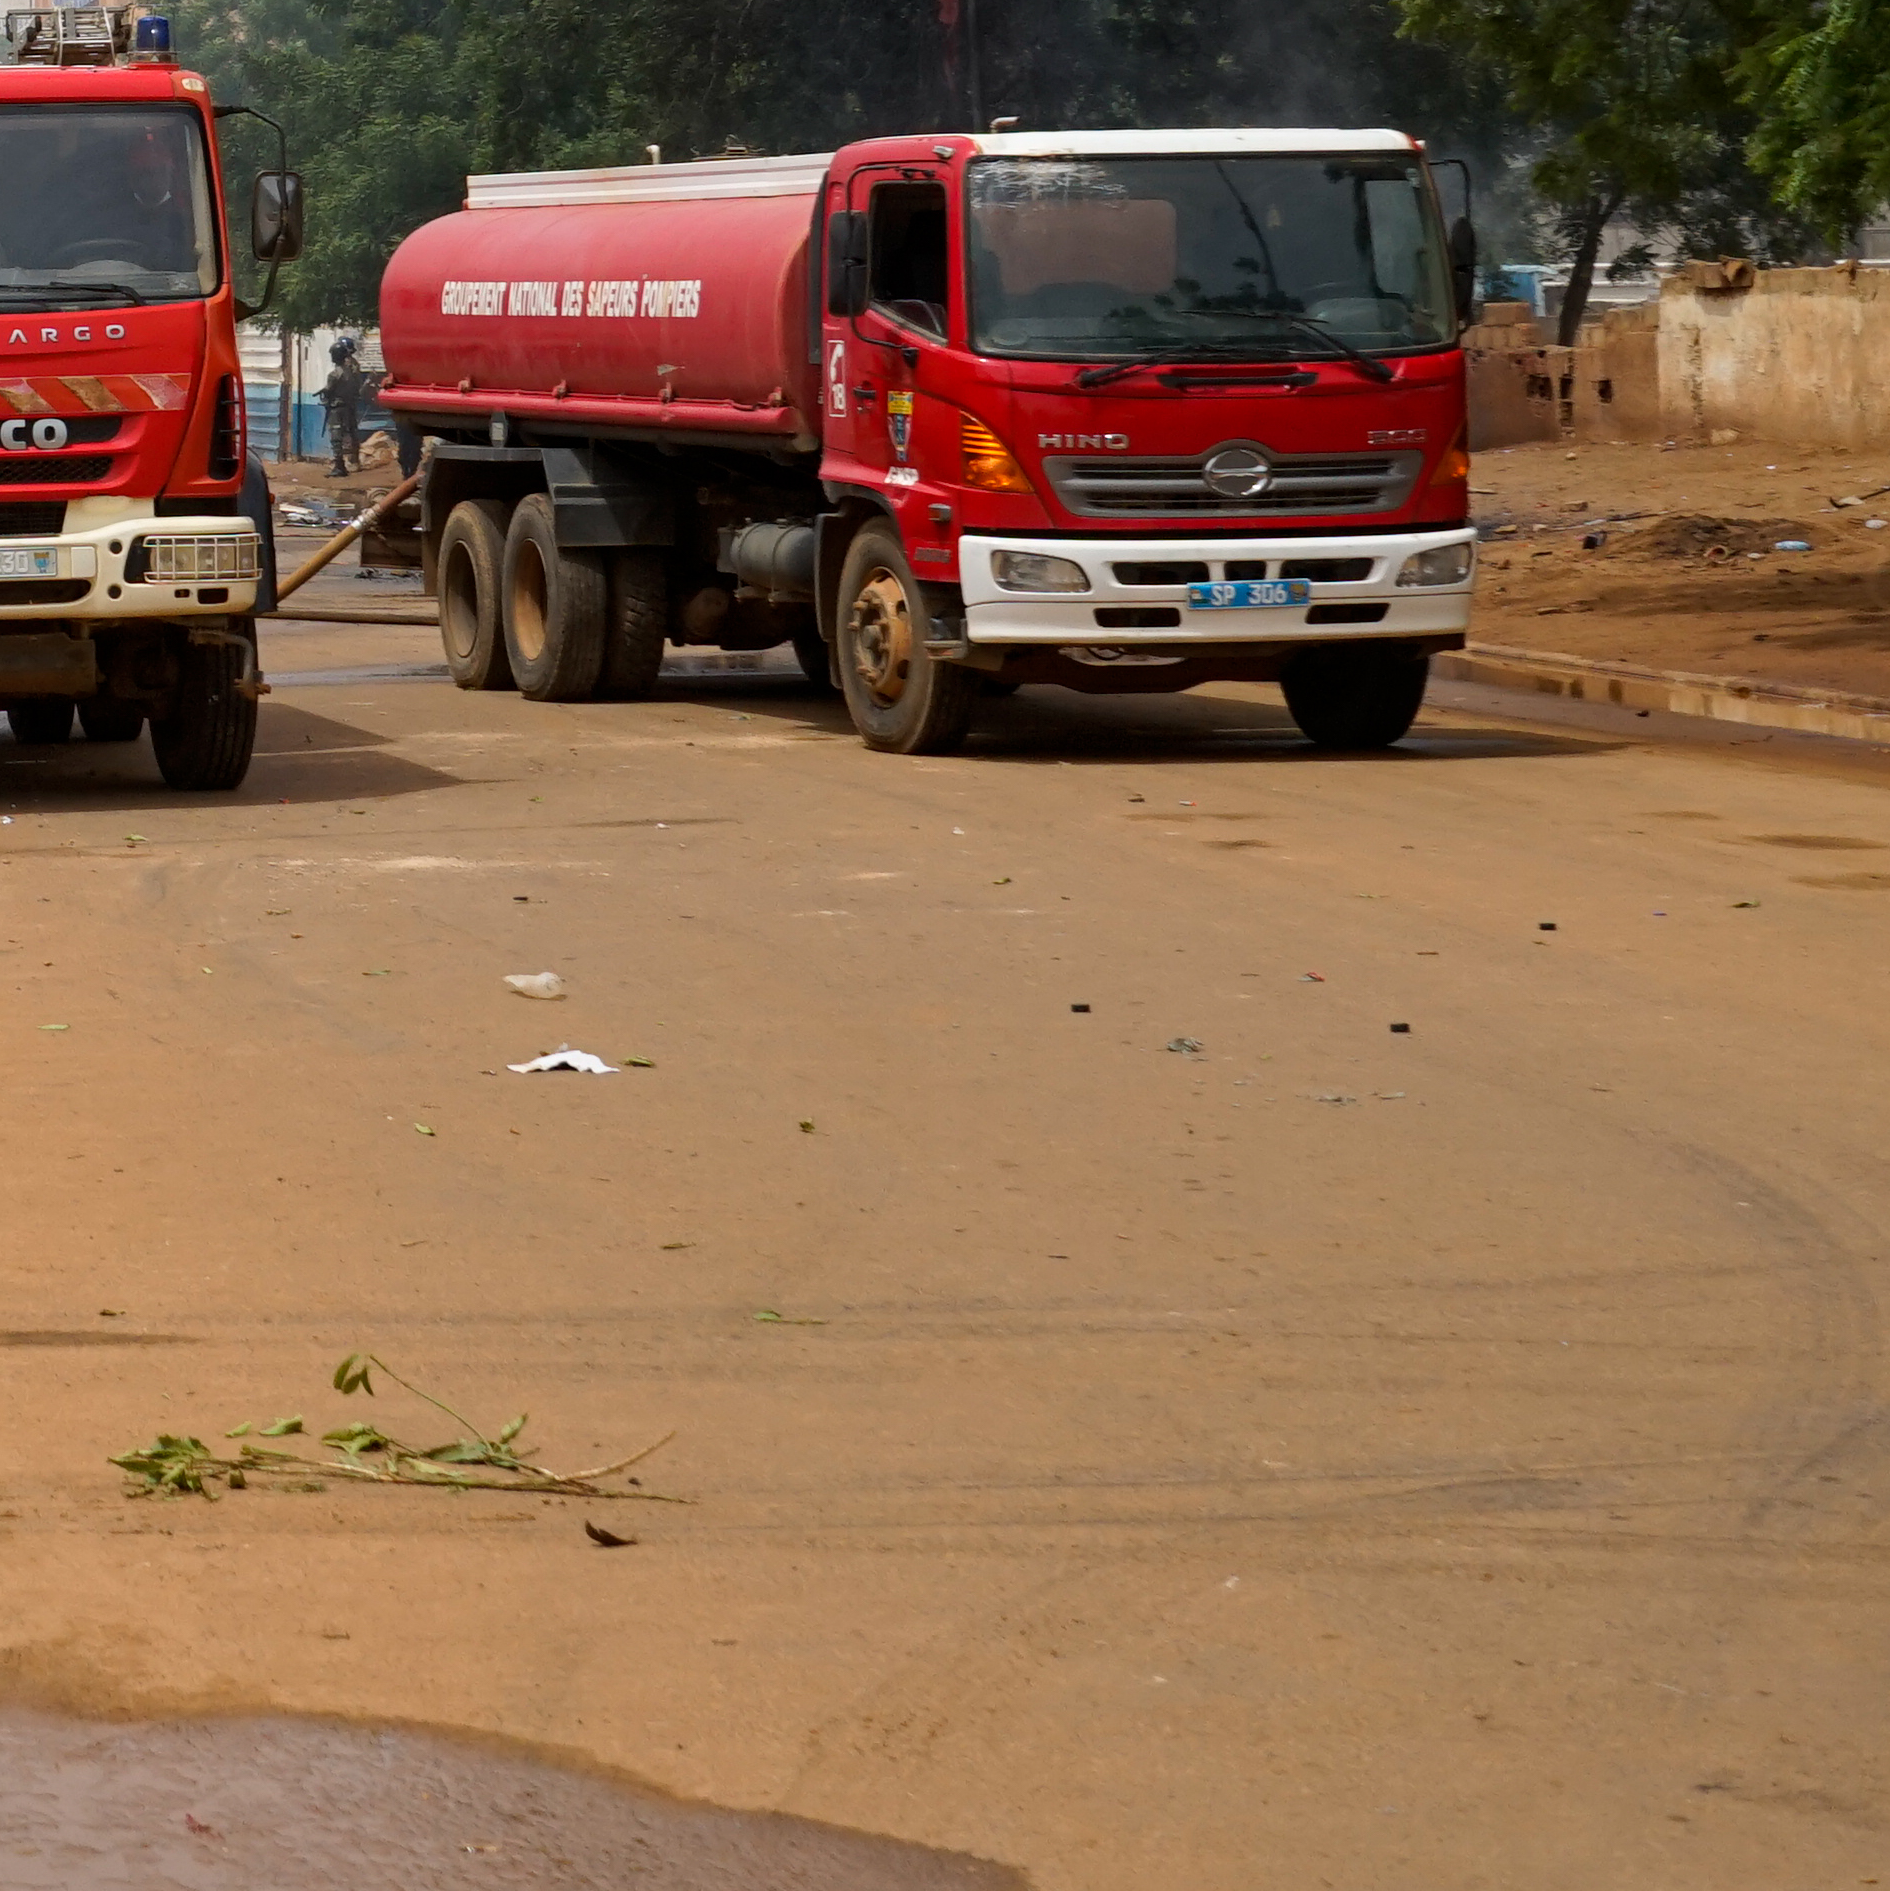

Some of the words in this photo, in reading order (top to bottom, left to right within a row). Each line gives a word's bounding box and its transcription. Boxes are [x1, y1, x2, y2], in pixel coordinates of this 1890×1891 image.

[441, 280, 507, 316] GROUPEMENT
[507, 281, 559, 316] NATIONAL
[561, 280, 585, 317] DES
[586, 280, 639, 318] SAPEURS
[640, 279, 701, 318] POMPIERS
[831, 382, 846, 410] 18
[1037, 432, 1130, 449] HINO
[1211, 584, 1237, 607] SP
[1247, 583, 1288, 605] 306
